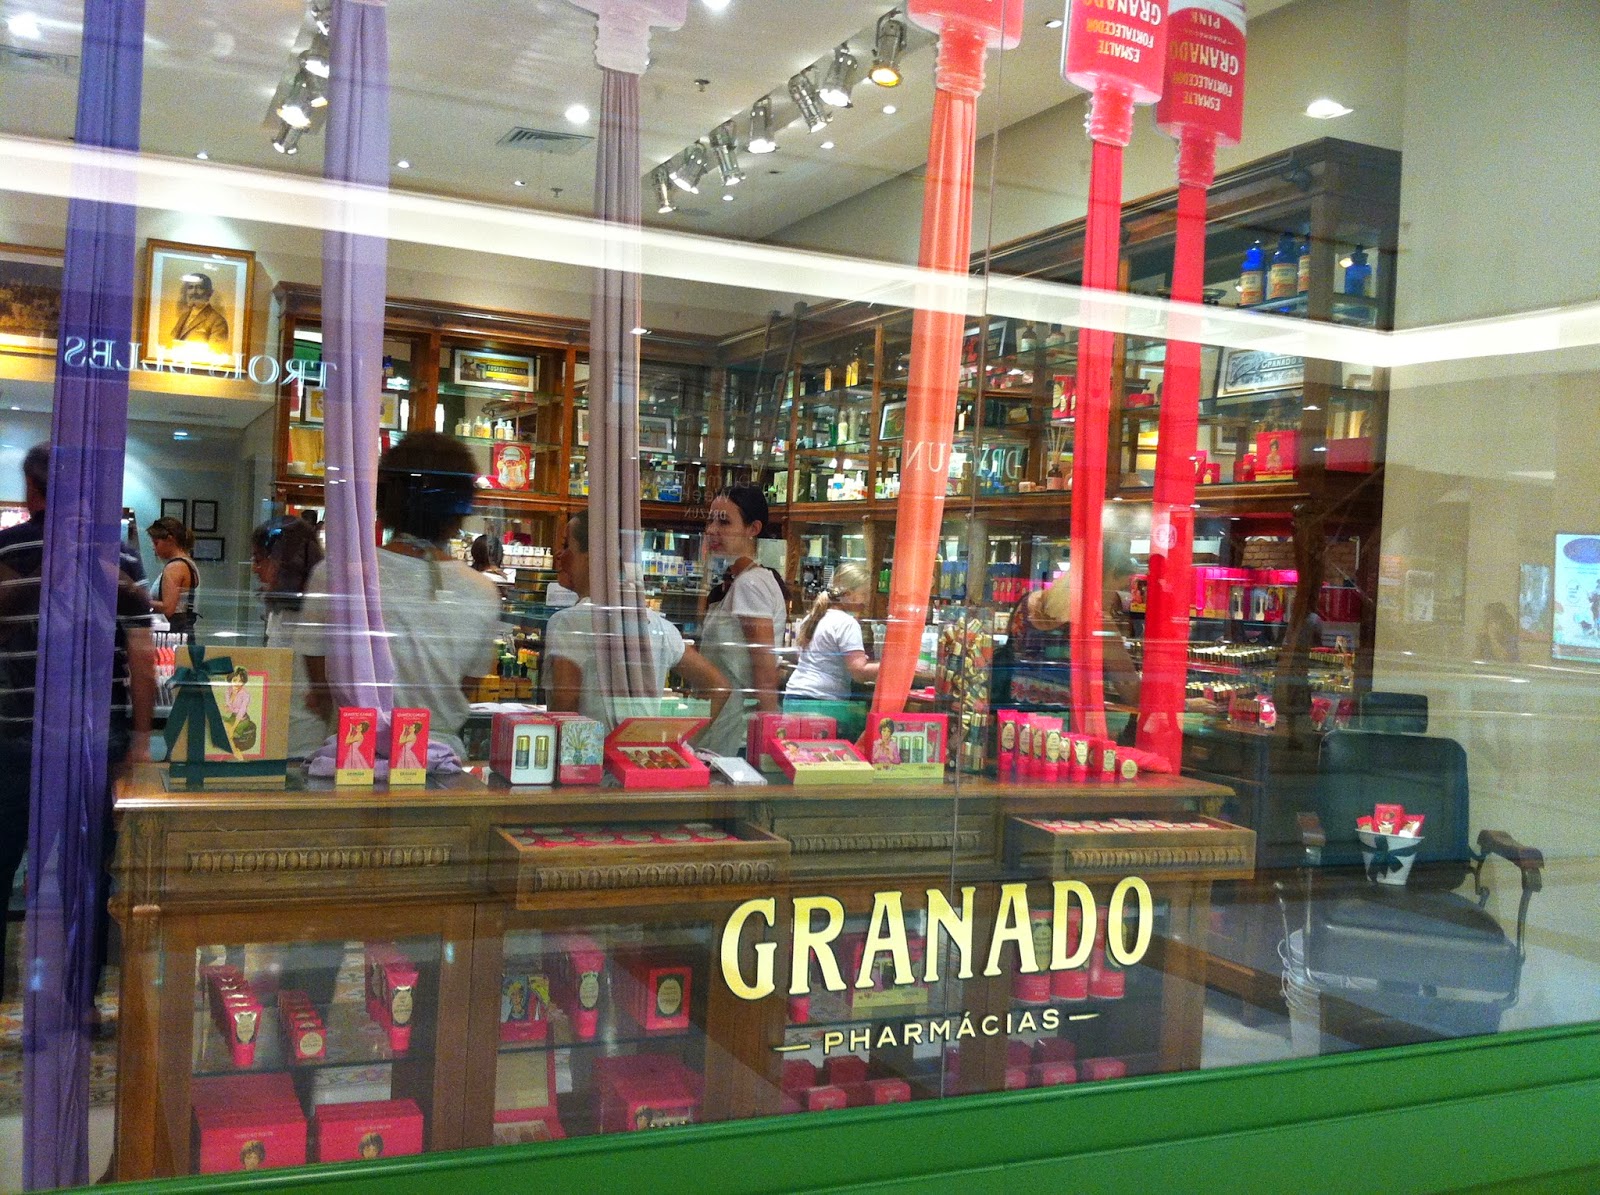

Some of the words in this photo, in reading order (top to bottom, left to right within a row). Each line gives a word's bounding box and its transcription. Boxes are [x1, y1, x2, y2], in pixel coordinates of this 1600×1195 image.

[1086, 18, 1155, 48] FORTALECEDOR
[1190, 11, 1221, 29] PINK
[1098, 39, 1140, 63] ESMALTE
[1169, 40, 1239, 76] GRANADO
[1172, 72, 1233, 97] FORTALECEDOR
[1182, 91, 1221, 111] ESMALTE
[720, 876, 1153, 1000] GRANADO
[823, 1008, 1060, 1054] PHARMÁCIAS
